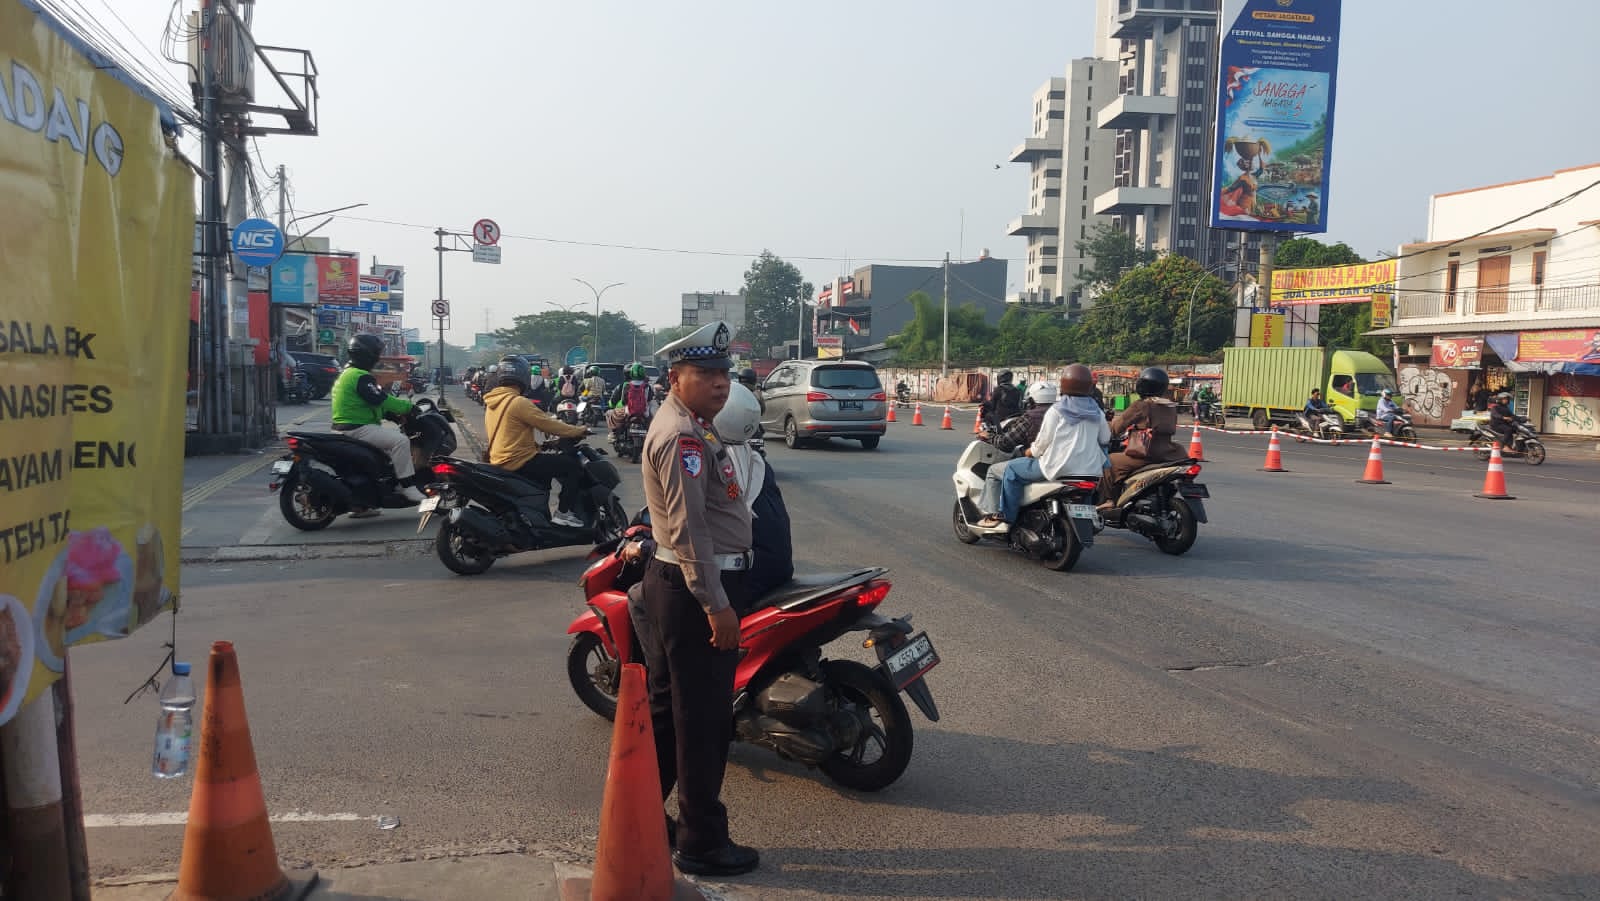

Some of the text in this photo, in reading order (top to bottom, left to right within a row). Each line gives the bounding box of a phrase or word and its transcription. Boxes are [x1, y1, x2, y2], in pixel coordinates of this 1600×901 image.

[1231, 29, 1265, 38] FESTIVAL
[237, 230, 276, 248] NCS
[1275, 264, 1390, 289] GUDANG NUSA PLAFON
[435, 302, 446, 314] S
